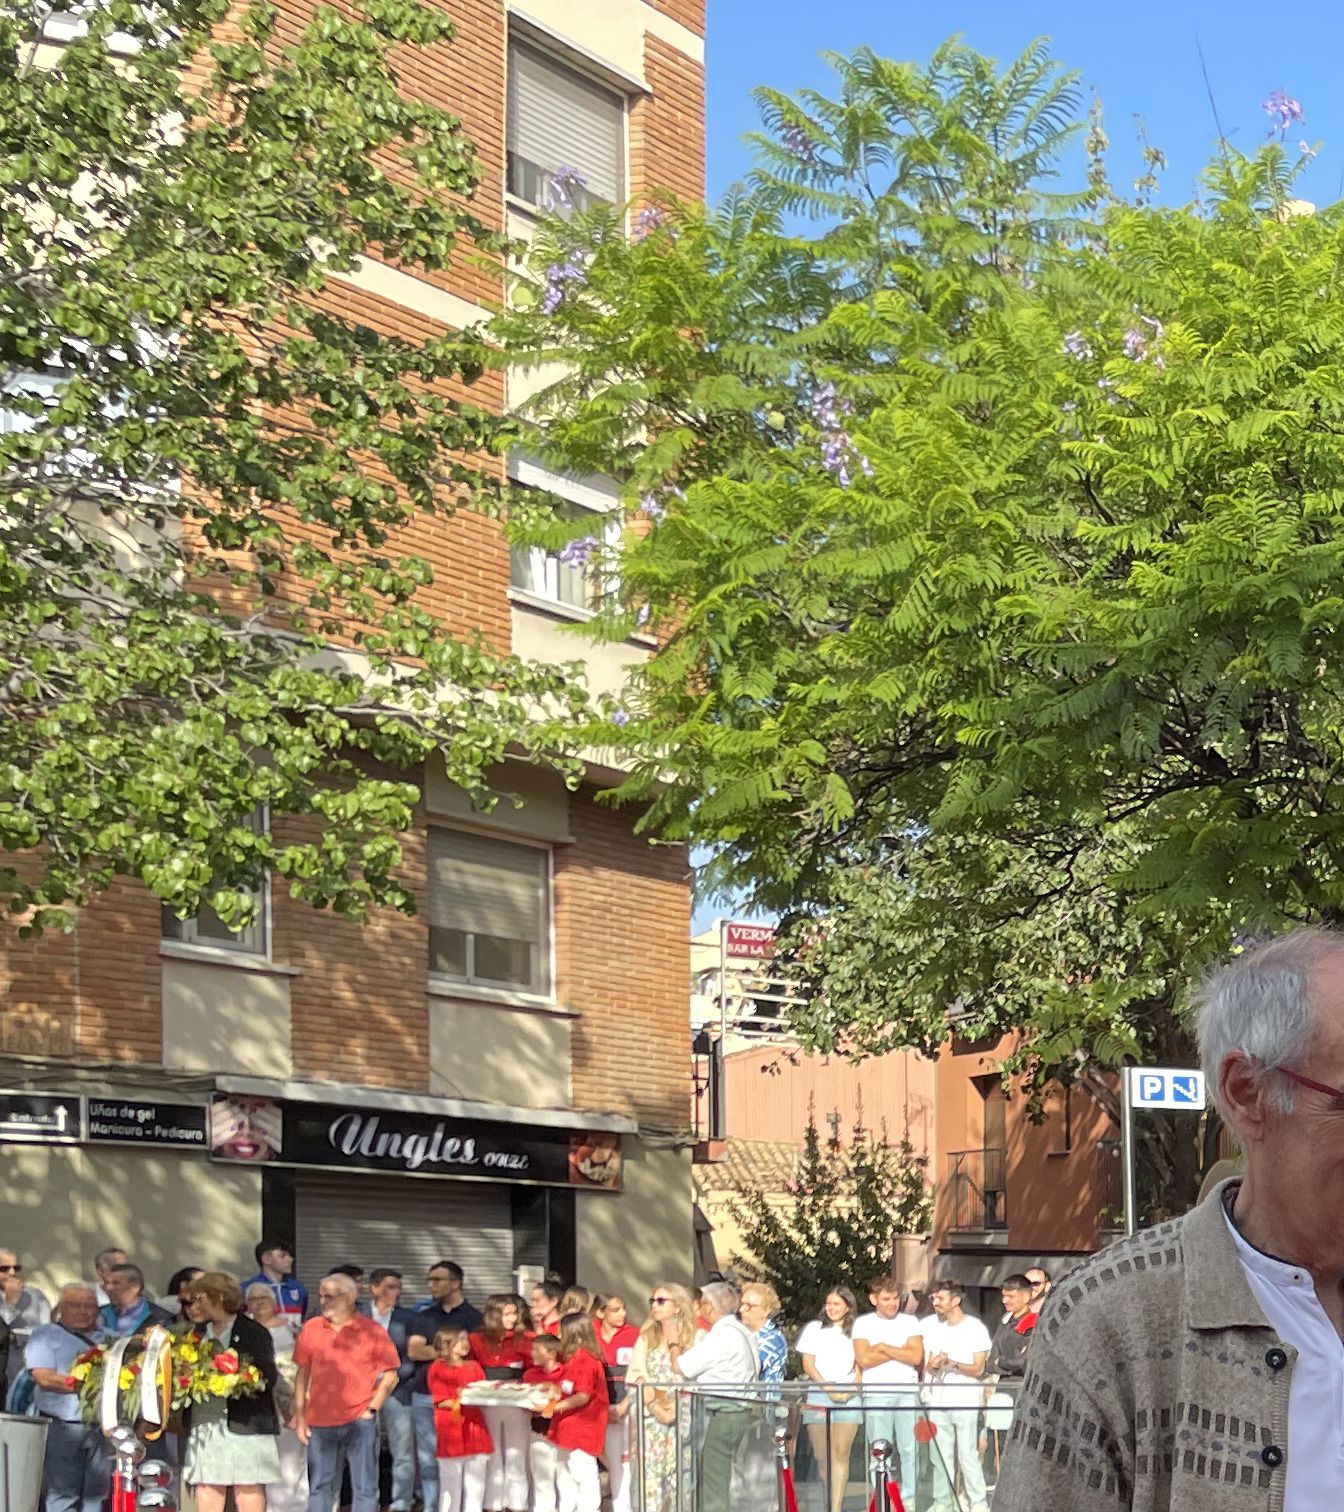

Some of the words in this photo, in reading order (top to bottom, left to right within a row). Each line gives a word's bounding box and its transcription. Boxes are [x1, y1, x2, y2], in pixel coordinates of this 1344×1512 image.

[730, 927, 774, 941] VERM
[727, 943, 748, 953] BAR
[1144, 1076, 1161, 1100] P
[120, 1105, 135, 1119] de
[137, 1107, 156, 1123] gel
[90, 1122, 143, 1137] Manicura
[155, 1125, 204, 1140] Pedicura
[329, 1113, 478, 1168] Ungles
